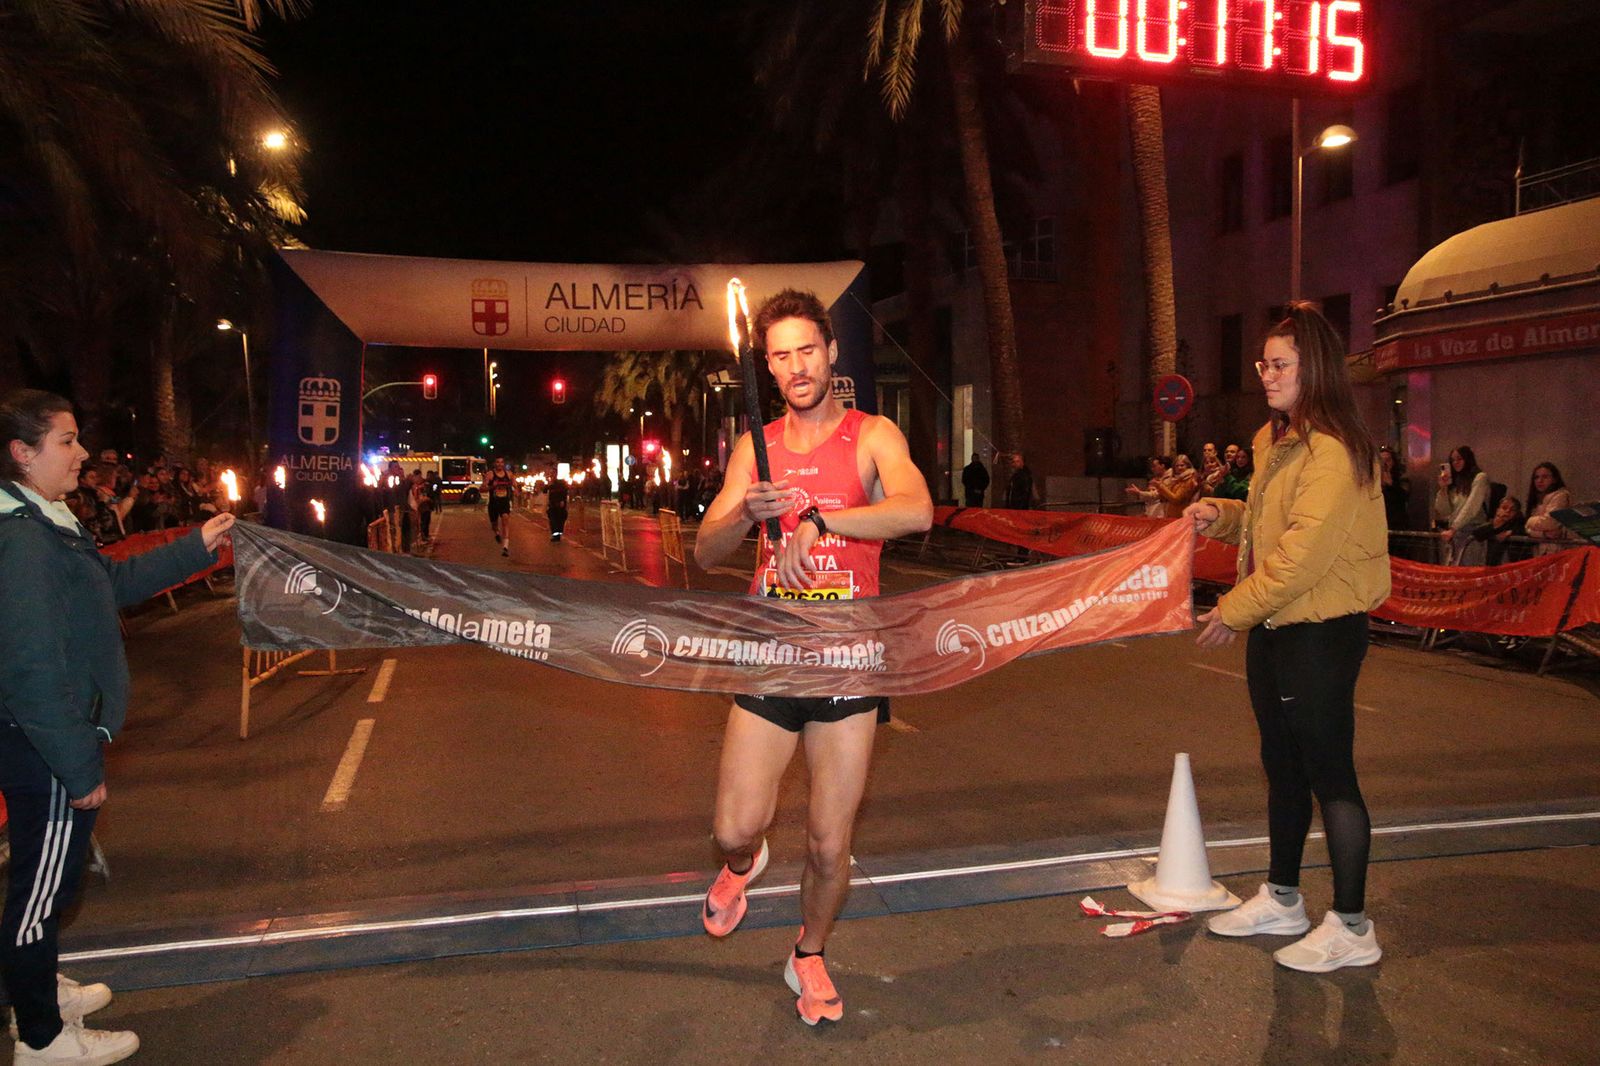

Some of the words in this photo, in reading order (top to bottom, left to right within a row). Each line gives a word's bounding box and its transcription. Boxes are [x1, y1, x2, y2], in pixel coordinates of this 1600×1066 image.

[545, 278, 703, 311] ALMERÍA
[544, 315, 627, 334] CIUDAD
[1487, 332, 1514, 351] de
[280, 452, 353, 471] ALMERÍA
[296, 471, 338, 482] CIUDAD
